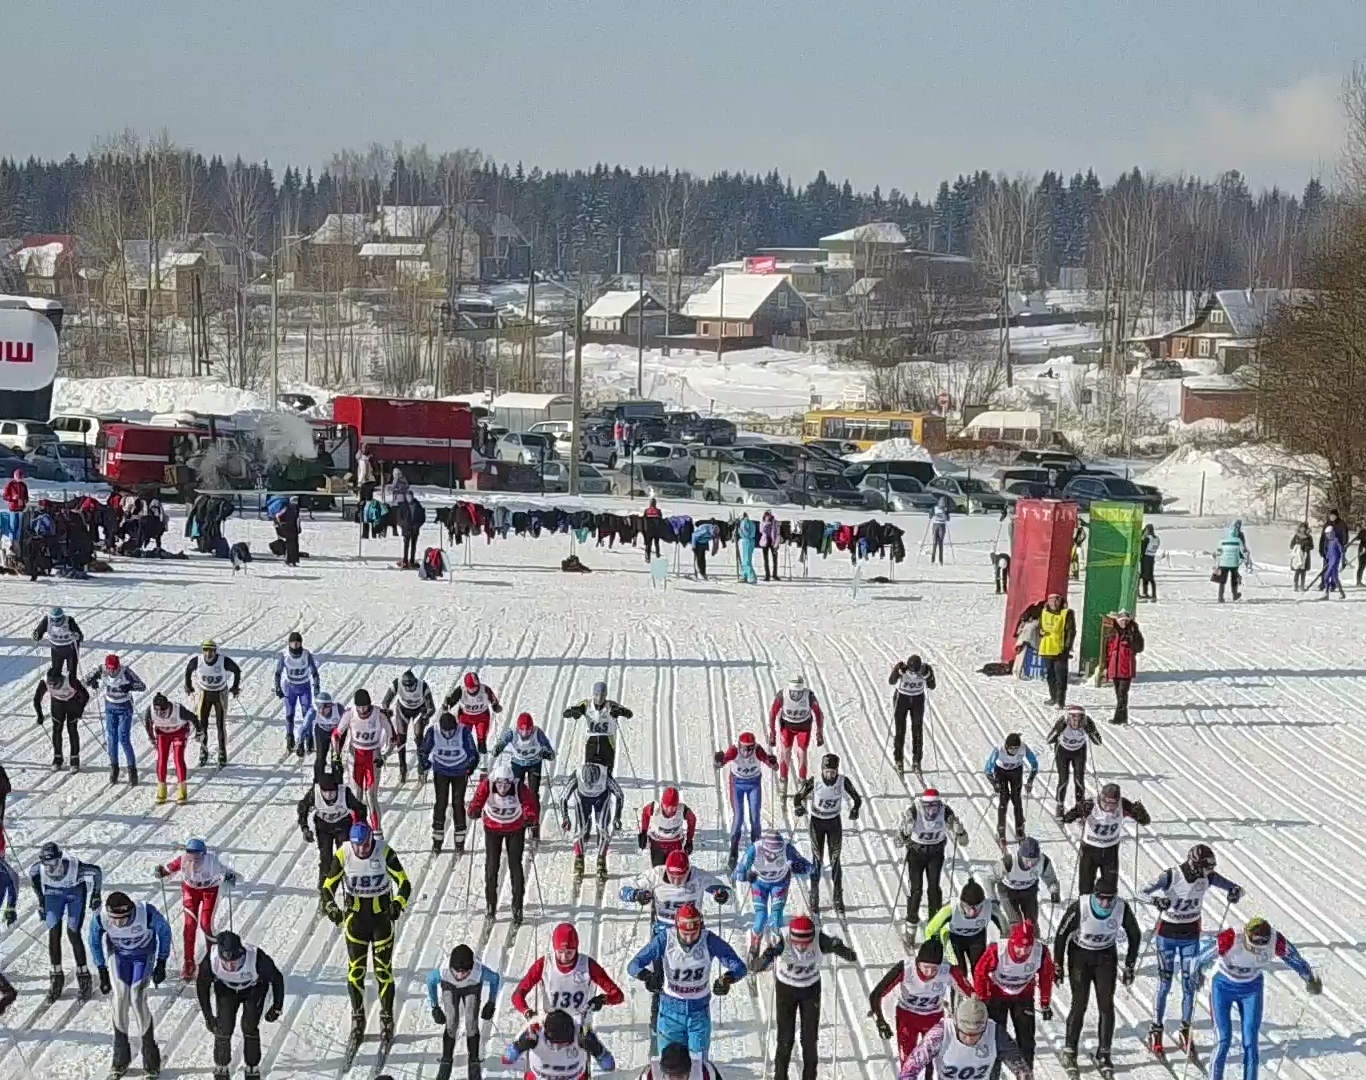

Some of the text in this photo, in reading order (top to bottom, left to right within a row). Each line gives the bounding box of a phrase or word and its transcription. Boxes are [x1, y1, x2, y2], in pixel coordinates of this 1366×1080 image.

[588, 721, 610, 734] 165
[550, 991, 585, 1009] 139
[943, 1064, 990, 1080] 202
